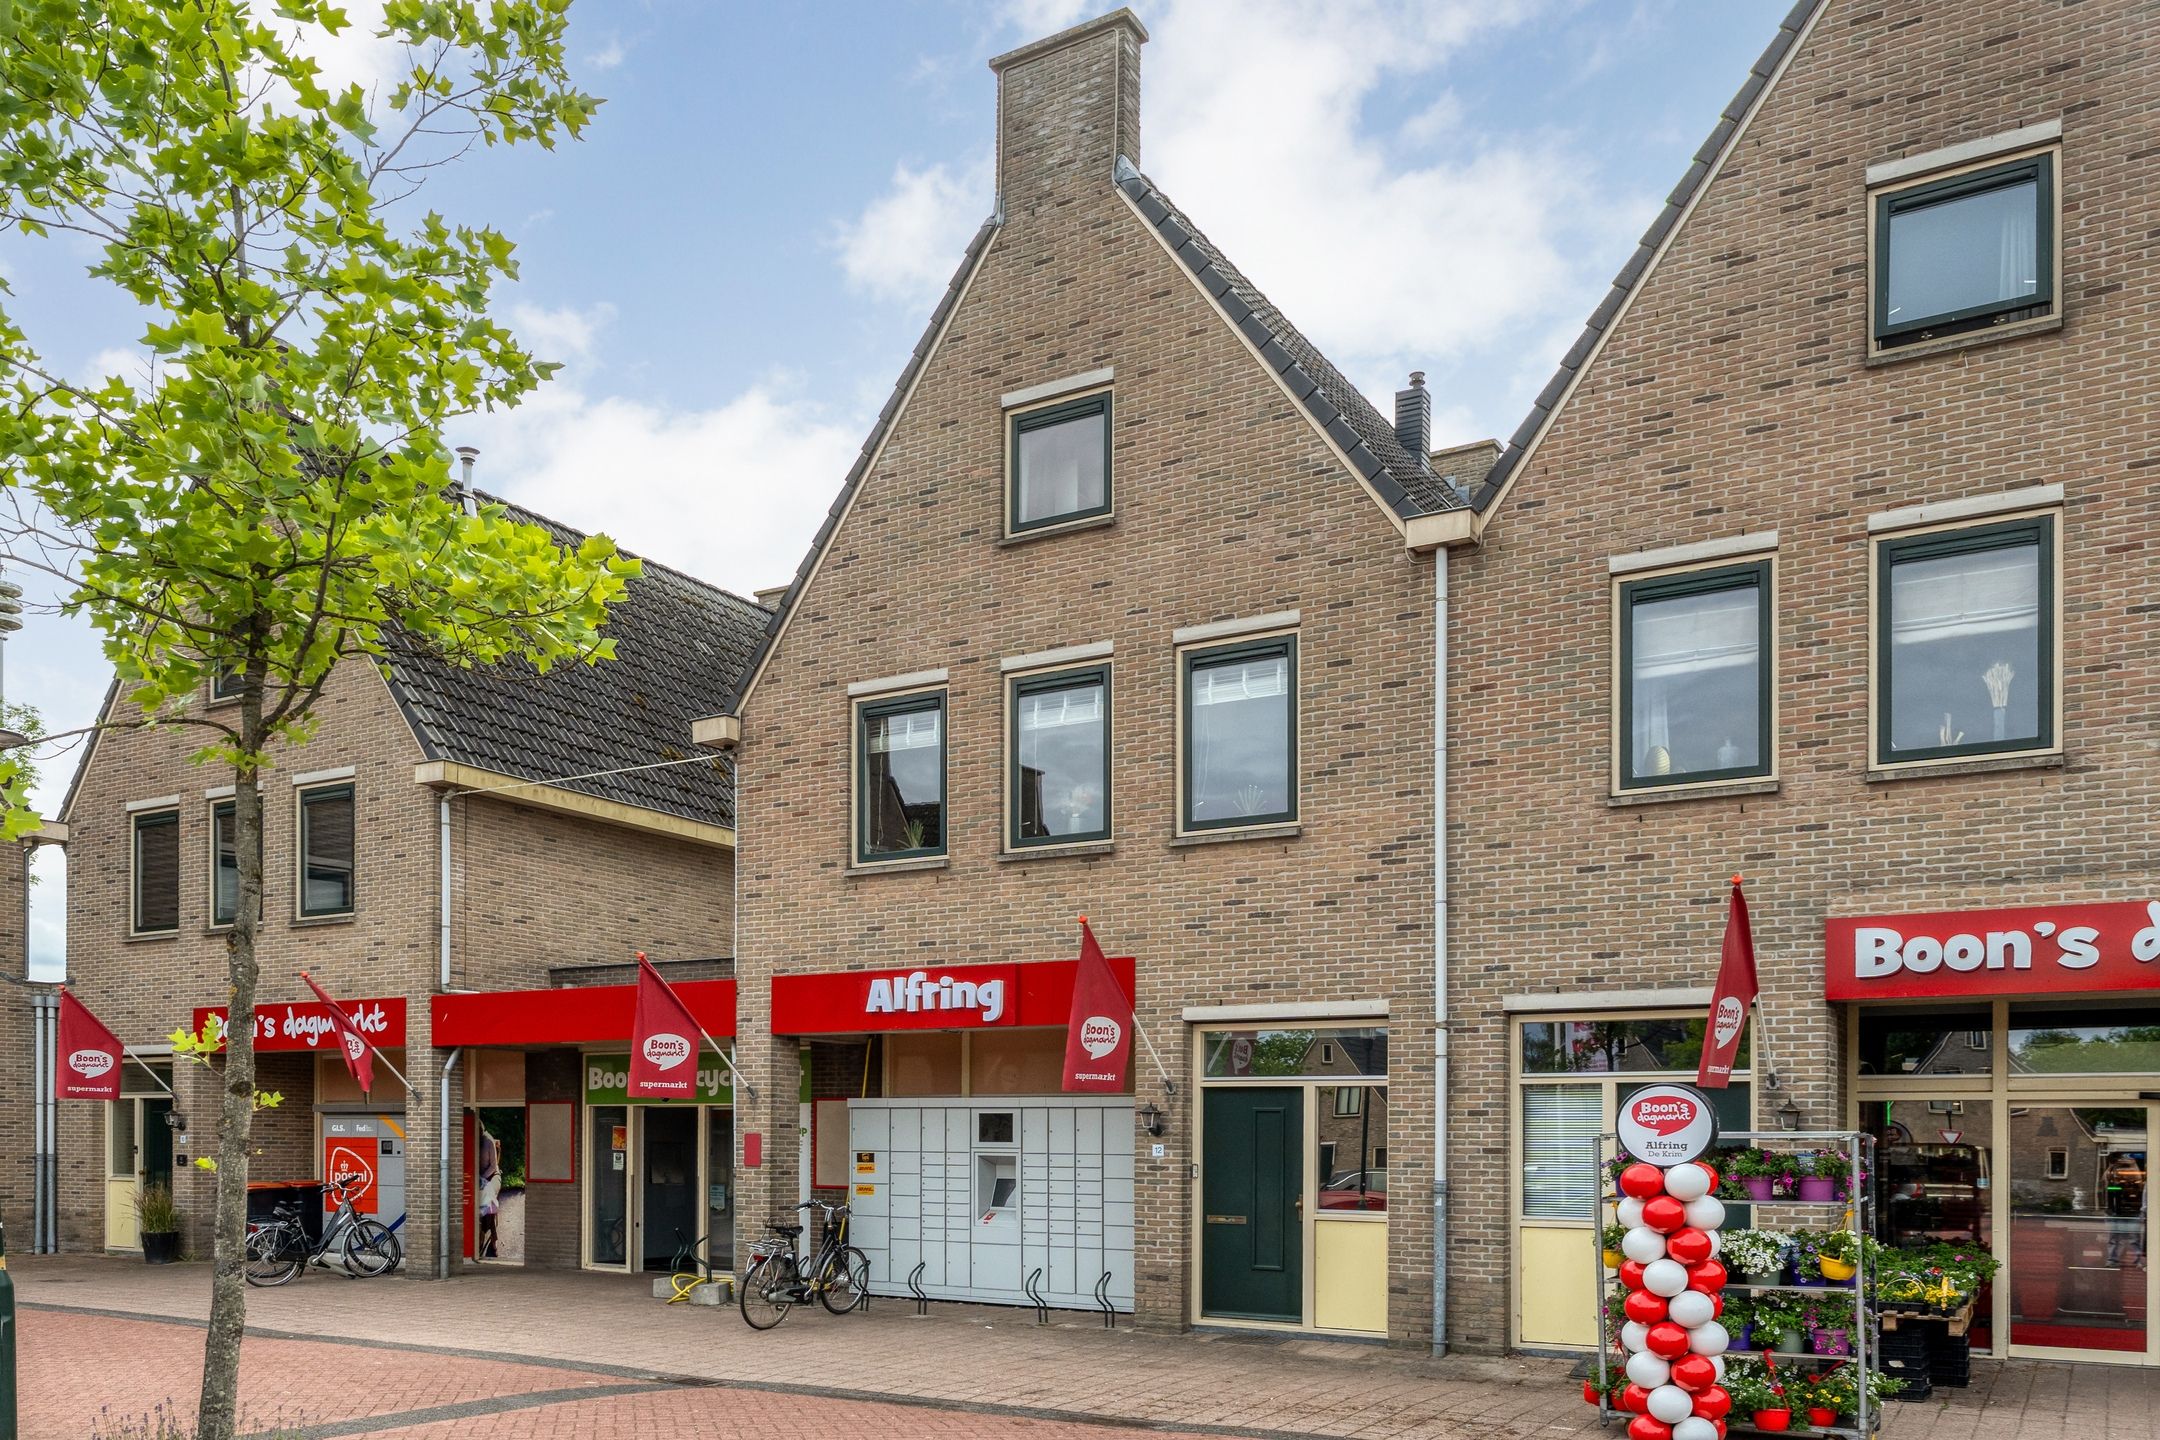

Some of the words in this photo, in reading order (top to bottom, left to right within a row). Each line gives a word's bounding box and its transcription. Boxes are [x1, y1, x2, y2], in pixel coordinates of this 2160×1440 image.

[1855, 921, 2100, 978] Boon's
[865, 971, 1004, 1022] Alfring
[1718, 1004, 1740, 1020] Boon's
[283, 1003, 388, 1046] dagmrkt
[1086, 1023, 1115, 1036] Boon's
[650, 1040, 684, 1050] Boon's
[75, 1054, 108, 1063] Boon's
[646, 1048, 686, 1060] dagmarkt
[72, 1061, 109, 1070] dagmarkt
[588, 1067, 629, 1090] Boo
[1074, 1072, 1116, 1082] supermarkt
[639, 1080, 688, 1089] supermarkt
[1640, 1101, 1689, 1114] Boon's
[1637, 1110, 1692, 1125] dagmarkt
[1154, 1146, 1163, 1154] 12
[1645, 1141, 1688, 1151] Alfring
